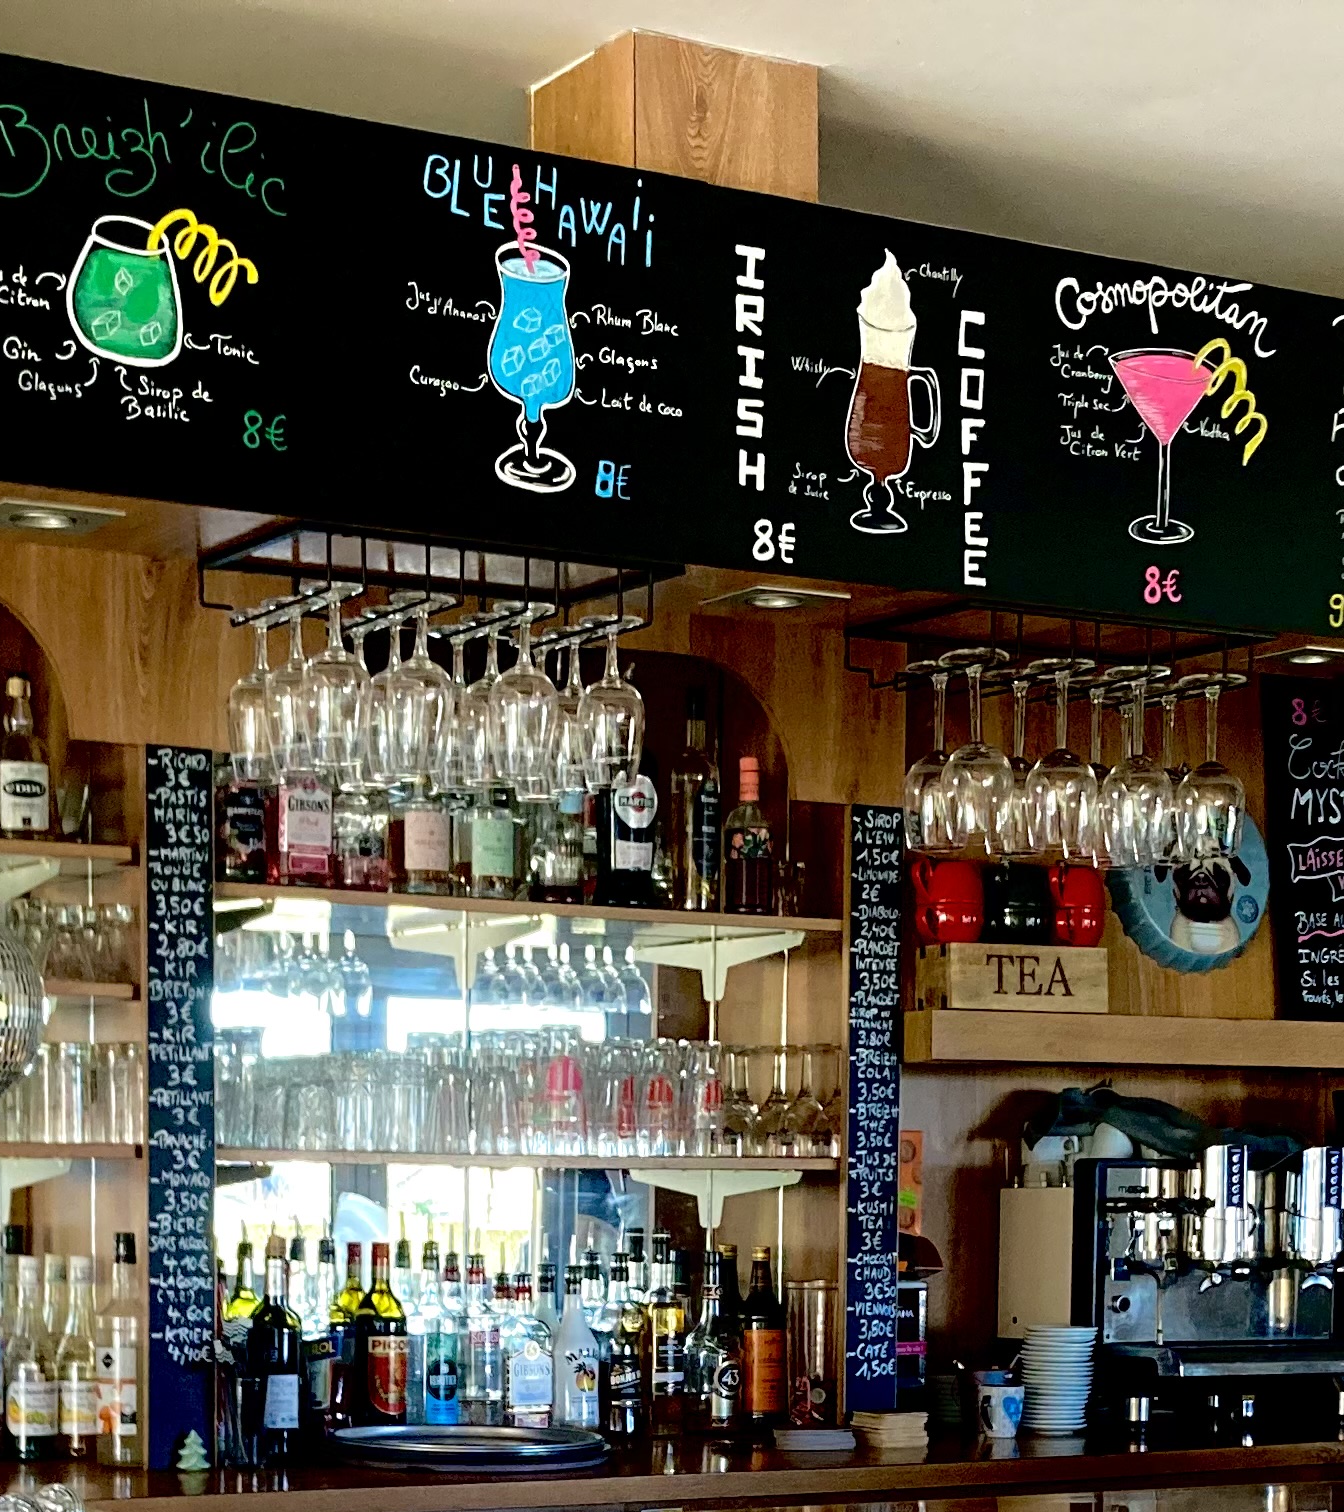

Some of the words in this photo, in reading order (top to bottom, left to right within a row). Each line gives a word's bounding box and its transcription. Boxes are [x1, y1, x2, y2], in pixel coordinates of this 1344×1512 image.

[423, 153, 506, 230] BLUE
[11, 264, 28, 287] de
[918, 262, 964, 299] Chantilly
[405, 281, 431, 312] Jus
[591, 303, 632, 329] Rhum
[635, 308, 679, 337] Blanc
[1054, 274, 1278, 359] Cosmopolitan
[2, 335, 42, 362] Gin
[208, 333, 260, 365] Tonic
[598, 346, 658, 374] Glaçons
[1049, 343, 1070, 367] Jus
[1073, 344, 1084, 361] de
[734, 243, 766, 492] IRISH
[1060, 362, 1114, 395] Cranberry
[136, 375, 184, 405] Sirop
[191, 380, 214, 403] de
[601, 387, 633, 411] Lait
[638, 393, 653, 414] de
[120, 395, 190, 423] Basilic
[1057, 392, 1089, 419] Triple
[242, 409, 288, 452] 8€
[1059, 424, 1082, 446] Jus
[1090, 424, 1105, 442] de
[957, 309, 990, 587] COFFEE
[1068, 440, 1109, 457] Citron
[1114, 442, 1142, 461] Vert
[594, 459, 632, 501] 8€
[791, 461, 827, 490] Sirop
[752, 518, 796, 564] 8€
[1143, 565, 1182, 605] 8€
[855, 847, 900, 867] 1,50€
[861, 883, 881, 903] 2€
[155, 893, 205, 921] 3,50€
[859, 921, 897, 940] 2,40€
[1294, 910, 1328, 936] BASE
[859, 970, 899, 991] 3,50€
[986, 953, 1074, 997] TEA
[1322, 970, 1340, 987] les
[857, 1081, 896, 1101] 3,50€
[856, 1131, 893, 1149] 3,50€
[854, 1149, 880, 1169] JUS
[859, 1181, 883, 1199] 3€
[858, 1215, 884, 1230] TEA
[860, 1230, 883, 1251] 3€
[864, 1282, 897, 1301] 3€50
[722, 1370, 740, 1386] 43
[854, 1358, 896, 1381] 1,50€
